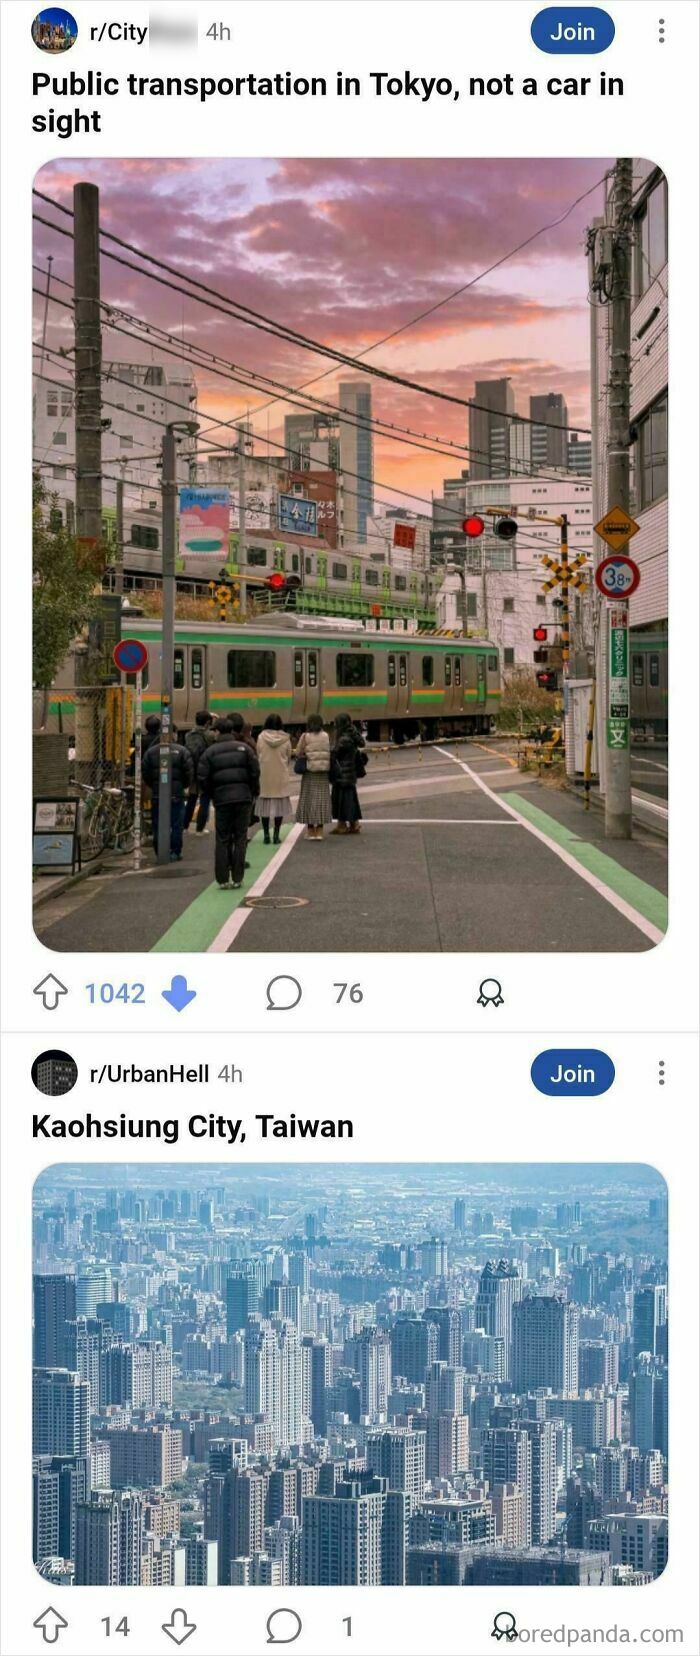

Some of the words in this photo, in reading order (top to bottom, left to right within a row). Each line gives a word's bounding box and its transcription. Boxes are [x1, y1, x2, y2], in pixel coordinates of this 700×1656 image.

[205, 22, 231, 41] 4h
[550, 22, 595, 41] Join
[32, 71, 119, 96] Public
[127, 72, 327, 103] transportation
[336, 72, 361, 96] in
[369, 71, 460, 102] Tokyo,
[469, 74, 514, 96] not
[522, 78, 538, 96] a
[546, 78, 592, 96] car
[600, 72, 624, 96] in
[32, 108, 102, 139] sight
[84, 982, 146, 1005] 1042
[333, 982, 364, 1004] 76
[90, 1063, 209, 1084] r/UrbanHell
[217, 1063, 243, 1083] 4h
[550, 1064, 595, 1083] Join
[32, 1113, 179, 1145] Kaohsiung
[188, 1113, 246, 1145] City,
[255, 1113, 354, 1138] Taiwan
[100, 1616, 131, 1637] 14
[342, 1616, 352, 1637] 1
